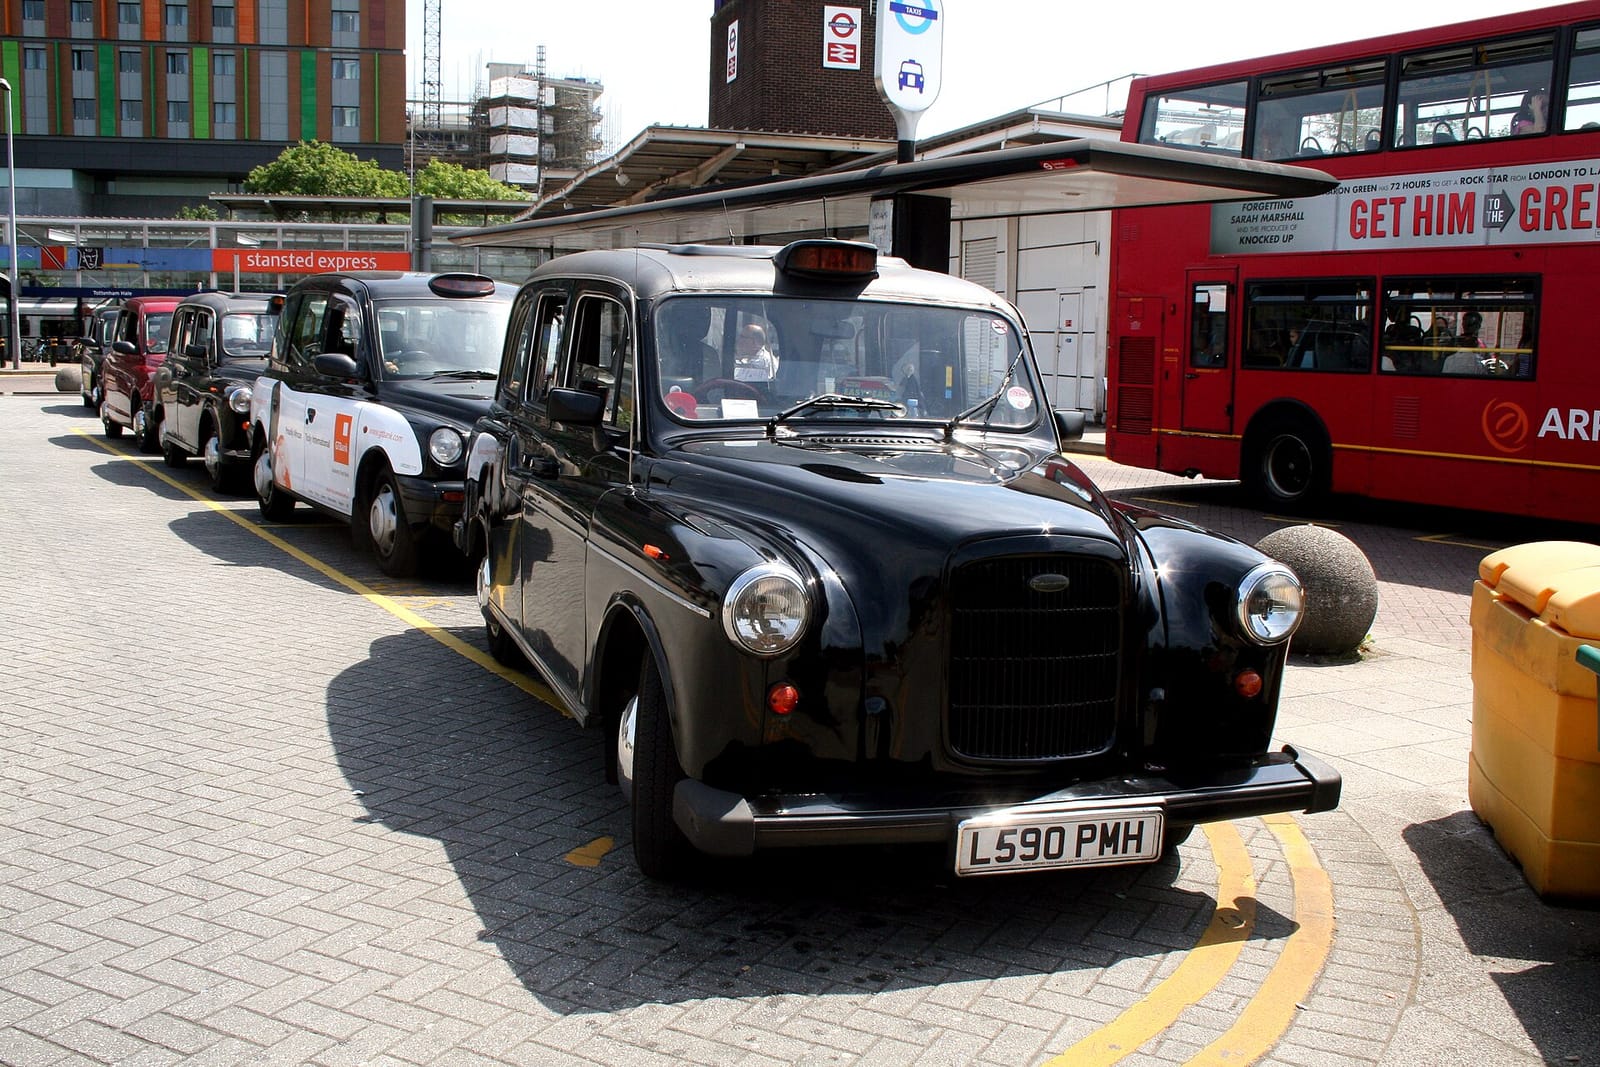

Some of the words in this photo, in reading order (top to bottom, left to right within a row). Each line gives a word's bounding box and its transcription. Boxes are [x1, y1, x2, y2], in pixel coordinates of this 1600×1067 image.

[905, 6, 923, 16] TAXIS
[1352, 184, 1377, 194] GREEN
[1390, 182, 1400, 191] 72
[1402, 180, 1431, 190] HOURS
[1460, 175, 1484, 185] ROCK
[1487, 174, 1508, 184] STAR
[1528, 169, 1571, 181] LONDON
[1573, 167, 1587, 177] TO
[1242, 200, 1294, 212] FORGETTING
[1489, 198, 1500, 210] TO
[1519, 183, 1600, 232] GRE
[1231, 213, 1258, 224] SARAH
[1260, 212, 1305, 223] MARSHALL
[1349, 196, 1407, 239] GET
[1413, 191, 1476, 237] HIM
[1486, 210, 1504, 223] THE
[1261, 224, 1289, 232] PRODUCER
[1239, 235, 1280, 245] KNOCKED
[1282, 234, 1294, 244] UP
[247, 252, 314, 268] stansted
[318, 255, 377, 272] express
[970, 826, 1066, 866] L590
[1075, 820, 1145, 858] PMH
